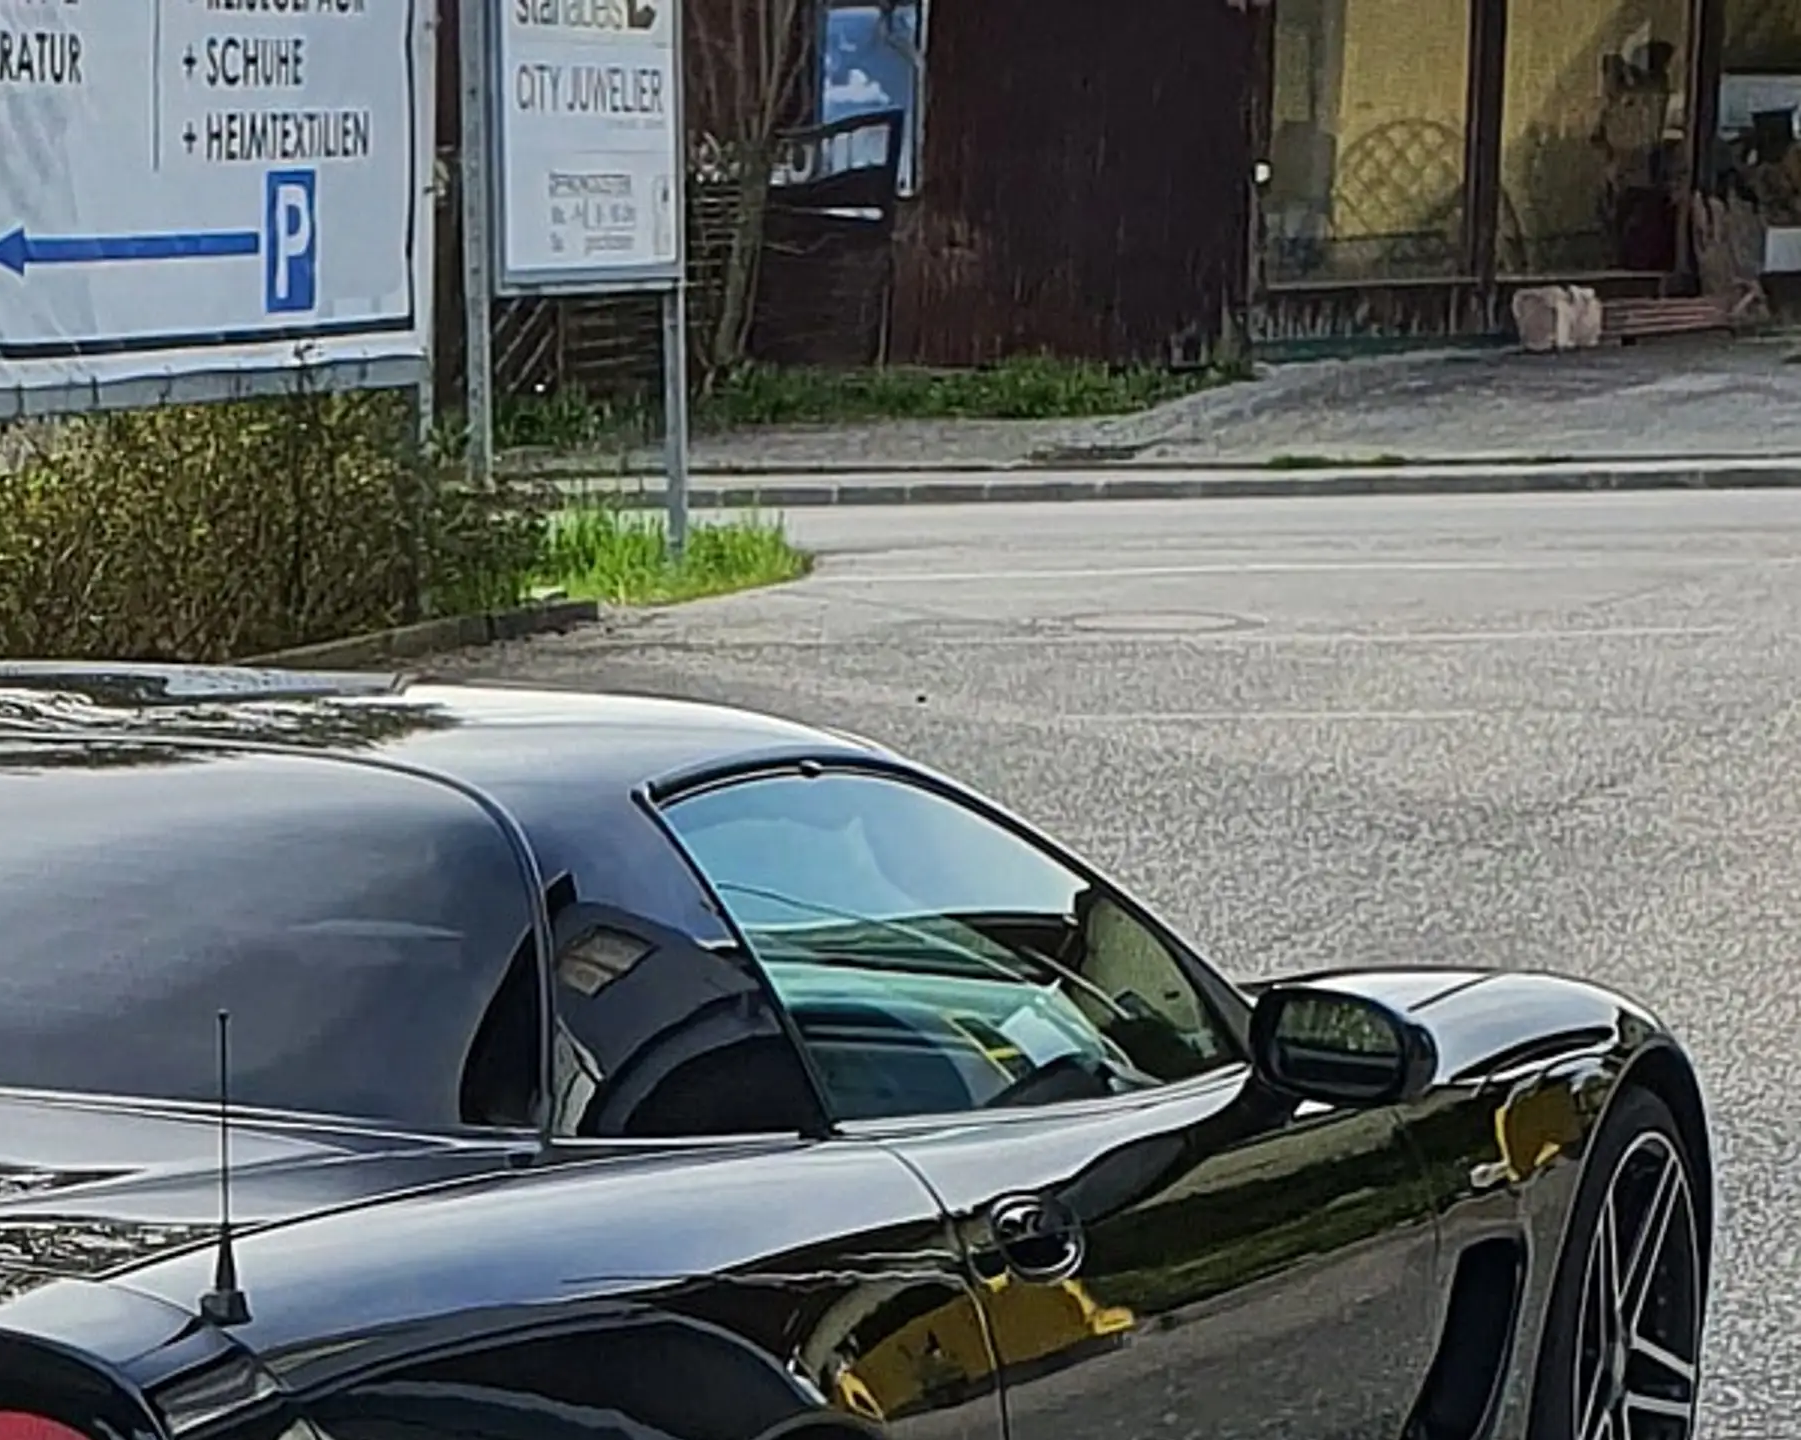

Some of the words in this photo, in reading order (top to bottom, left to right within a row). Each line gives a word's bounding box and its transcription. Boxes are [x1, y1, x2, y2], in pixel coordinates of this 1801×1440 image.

[206, 37, 303, 86] SCHUHE
[517, 64, 561, 113] CITY
[567, 66, 664, 113] JUWELIER
[206, 111, 369, 160] HEIMTEXTILIEN
[275, 183, 310, 299] P
